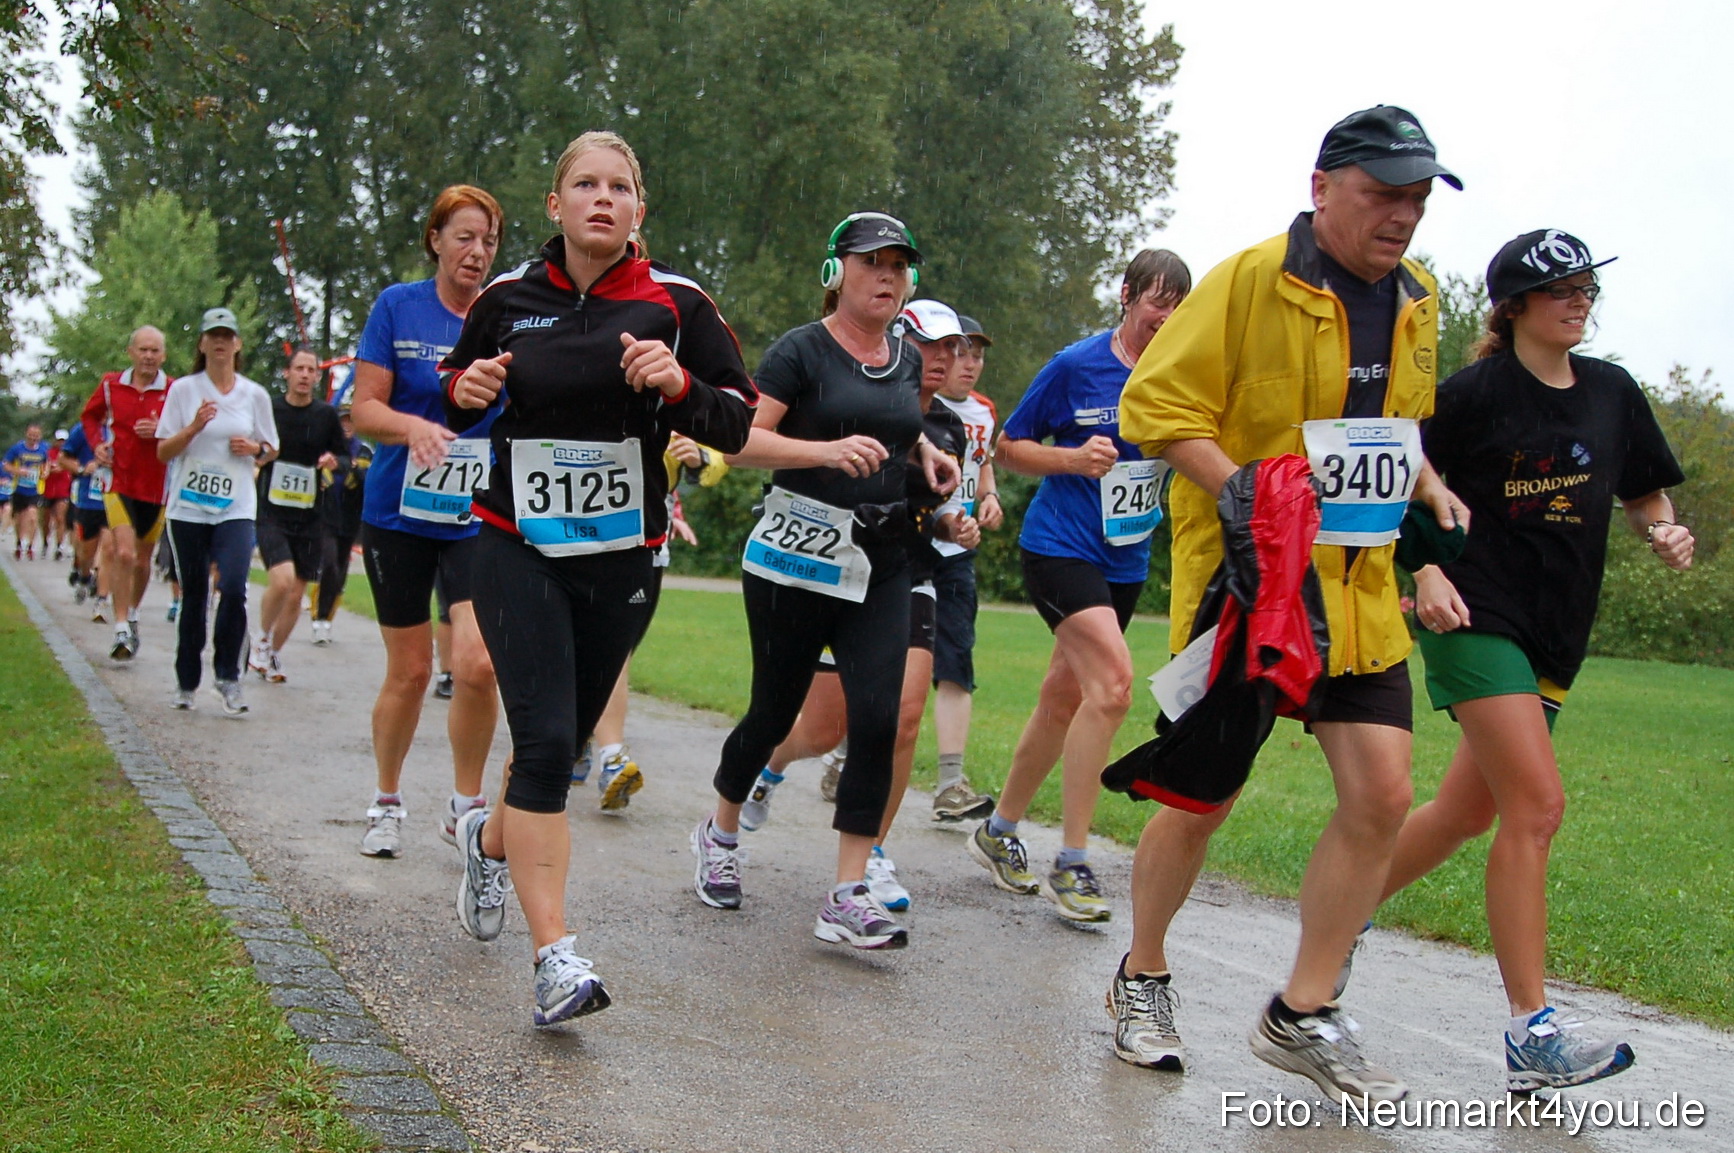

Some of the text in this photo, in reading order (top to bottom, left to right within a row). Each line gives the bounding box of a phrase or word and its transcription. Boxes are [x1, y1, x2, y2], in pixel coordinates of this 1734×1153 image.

[512, 316, 560, 332] saller
[1347, 426, 1393, 440] BOCK
[447, 444, 472, 454] OCK
[553, 447, 603, 461] BOCK
[186, 471, 233, 496] 2869
[281, 475, 309, 492] 511
[414, 461, 484, 492] 2712
[1322, 453, 1411, 499] 3401
[1504, 473, 1591, 497] BROADWAY
[527, 467, 631, 514] 3125
[790, 500, 829, 521] BOCK
[563, 522, 598, 539] Lisa
[760, 512, 842, 561] 2622
[763, 551, 818, 579] Gabriele
